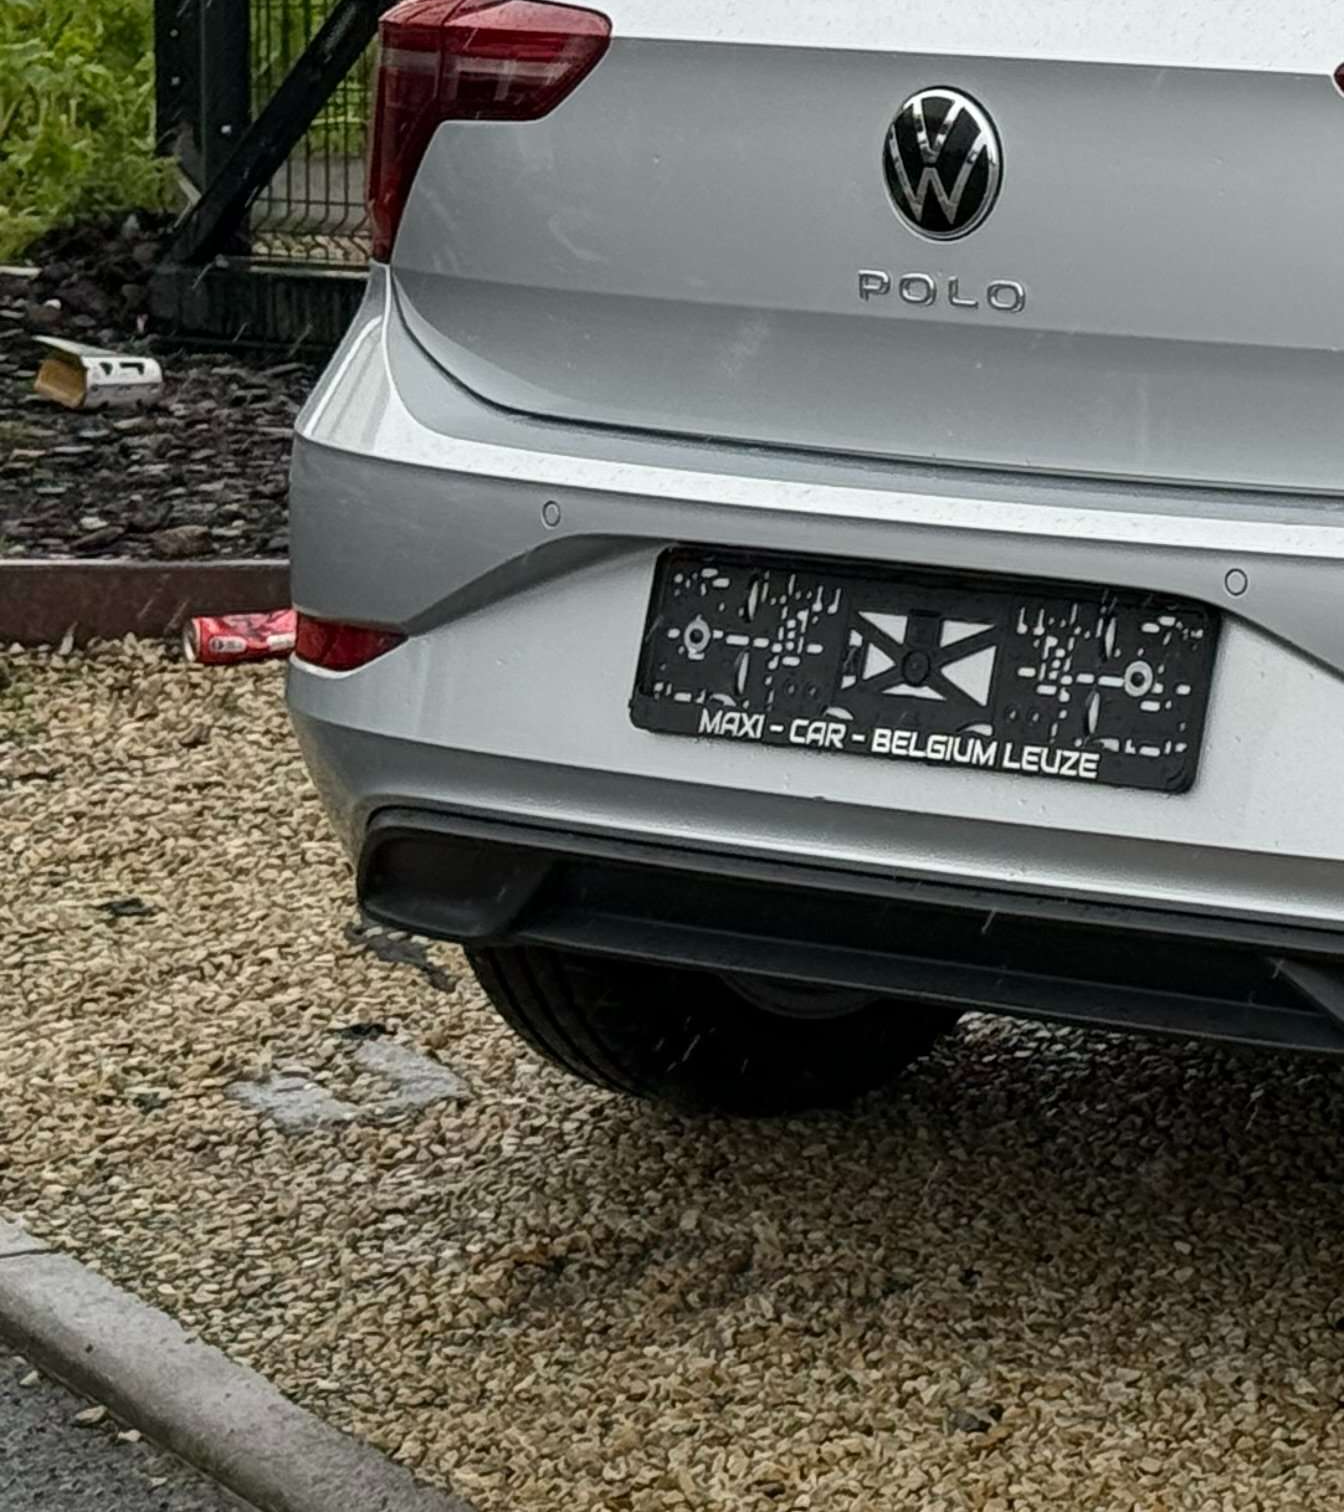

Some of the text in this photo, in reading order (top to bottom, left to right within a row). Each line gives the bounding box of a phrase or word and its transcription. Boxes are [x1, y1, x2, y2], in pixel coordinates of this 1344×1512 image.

[858, 269, 1026, 313] POLO
[698, 707, 766, 739] MAXI
[789, 718, 847, 749] CAR
[871, 728, 998, 767] BELGIUM
[1002, 742, 1100, 778] LEUZE
